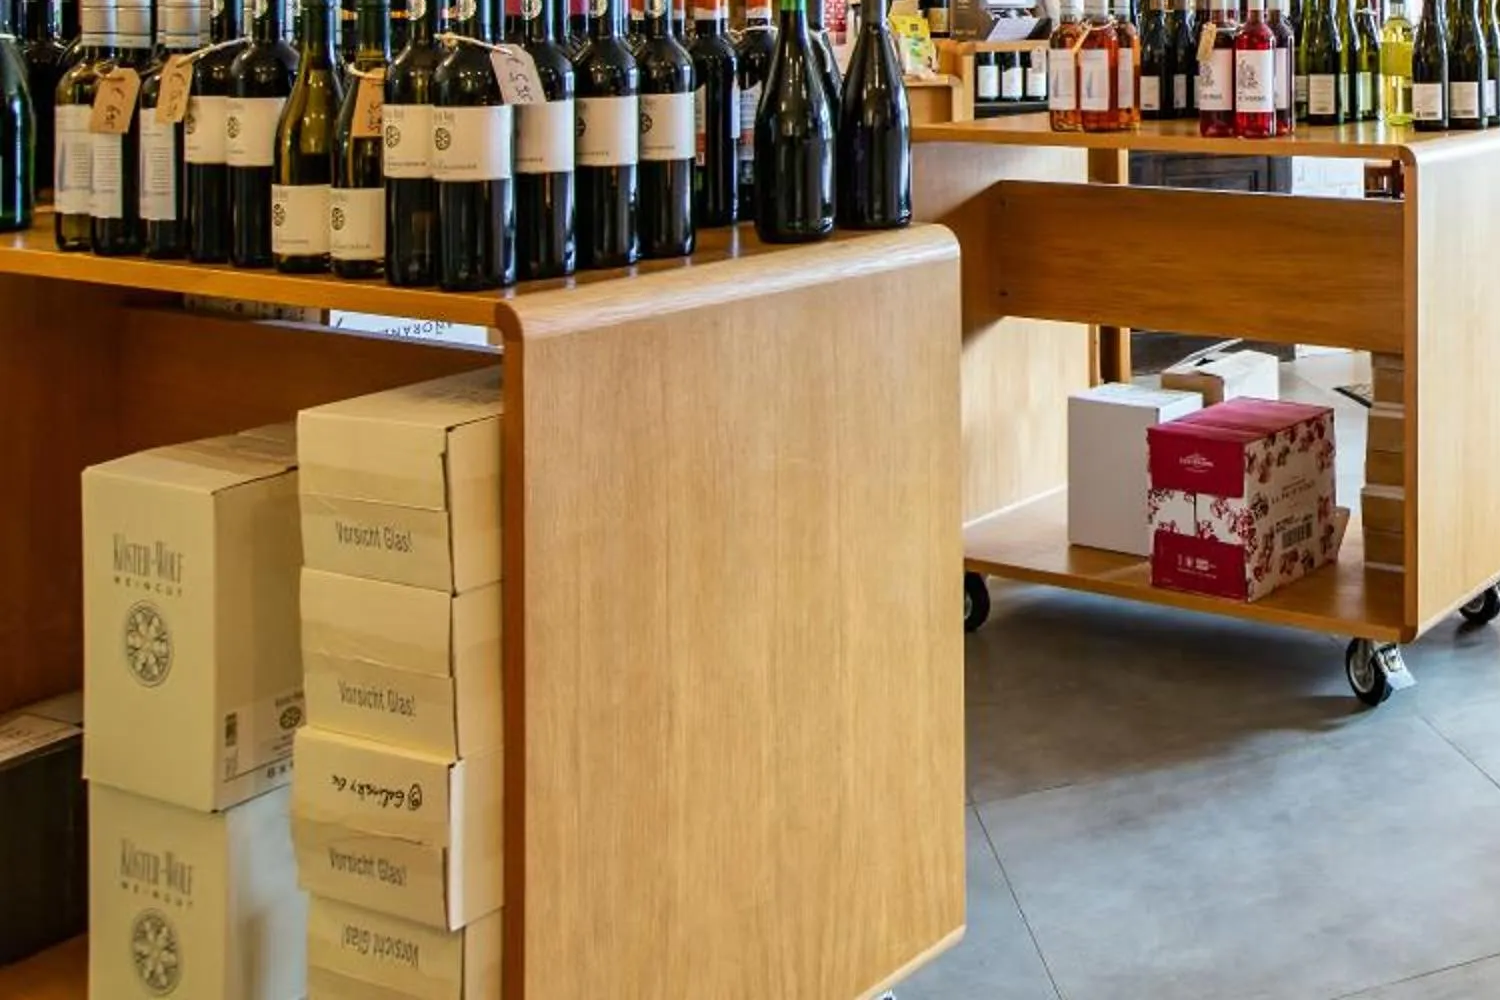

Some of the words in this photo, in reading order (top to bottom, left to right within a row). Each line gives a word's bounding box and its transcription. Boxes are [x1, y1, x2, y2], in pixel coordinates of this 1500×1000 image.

[335, 520, 381, 549] Vorsicht
[383, 525, 414, 553] Glas!
[337, 680, 384, 713] Vorsicht
[386, 688, 417, 718] Glas!
